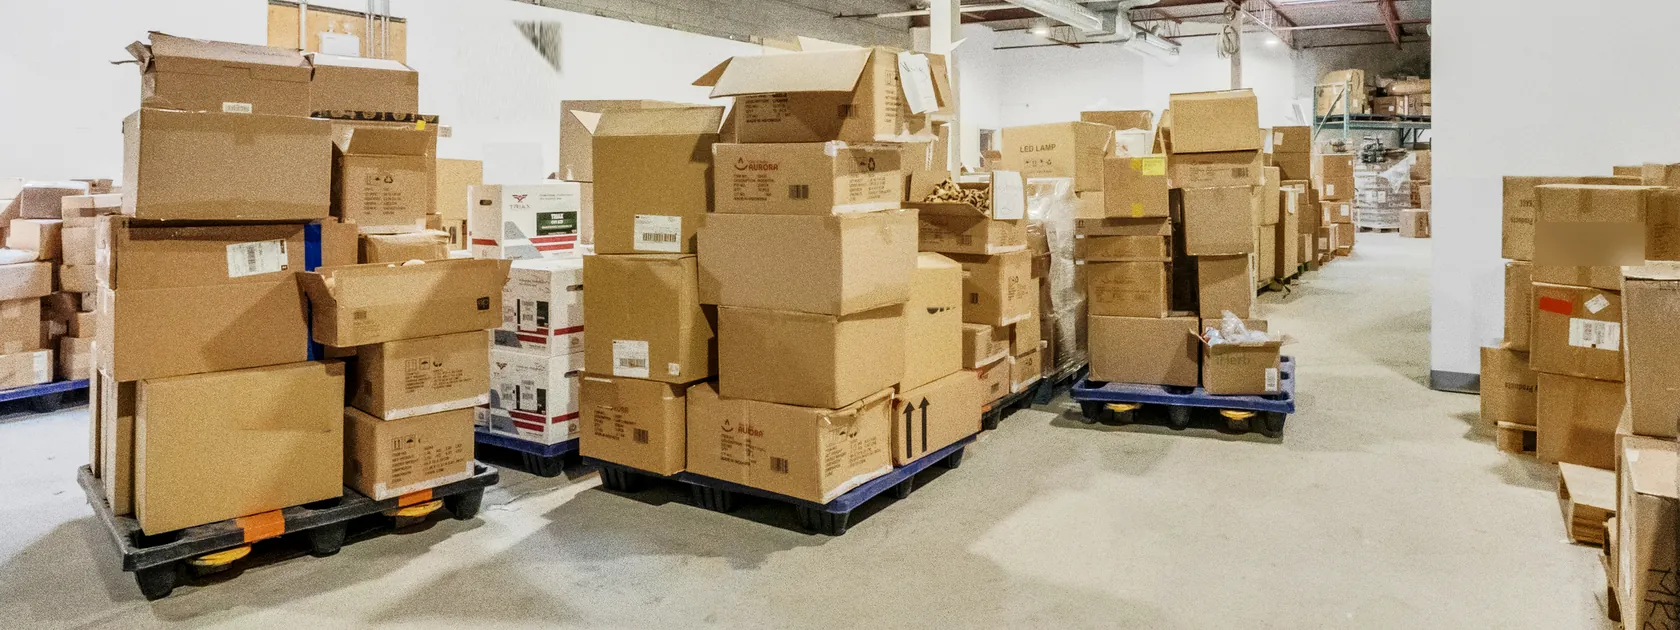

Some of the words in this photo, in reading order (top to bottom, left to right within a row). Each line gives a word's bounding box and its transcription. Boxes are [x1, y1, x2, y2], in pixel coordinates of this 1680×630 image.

[1020, 145, 1034, 153] LED
[1035, 143, 1057, 152] LAMP
[749, 163, 778, 171] AURORA
